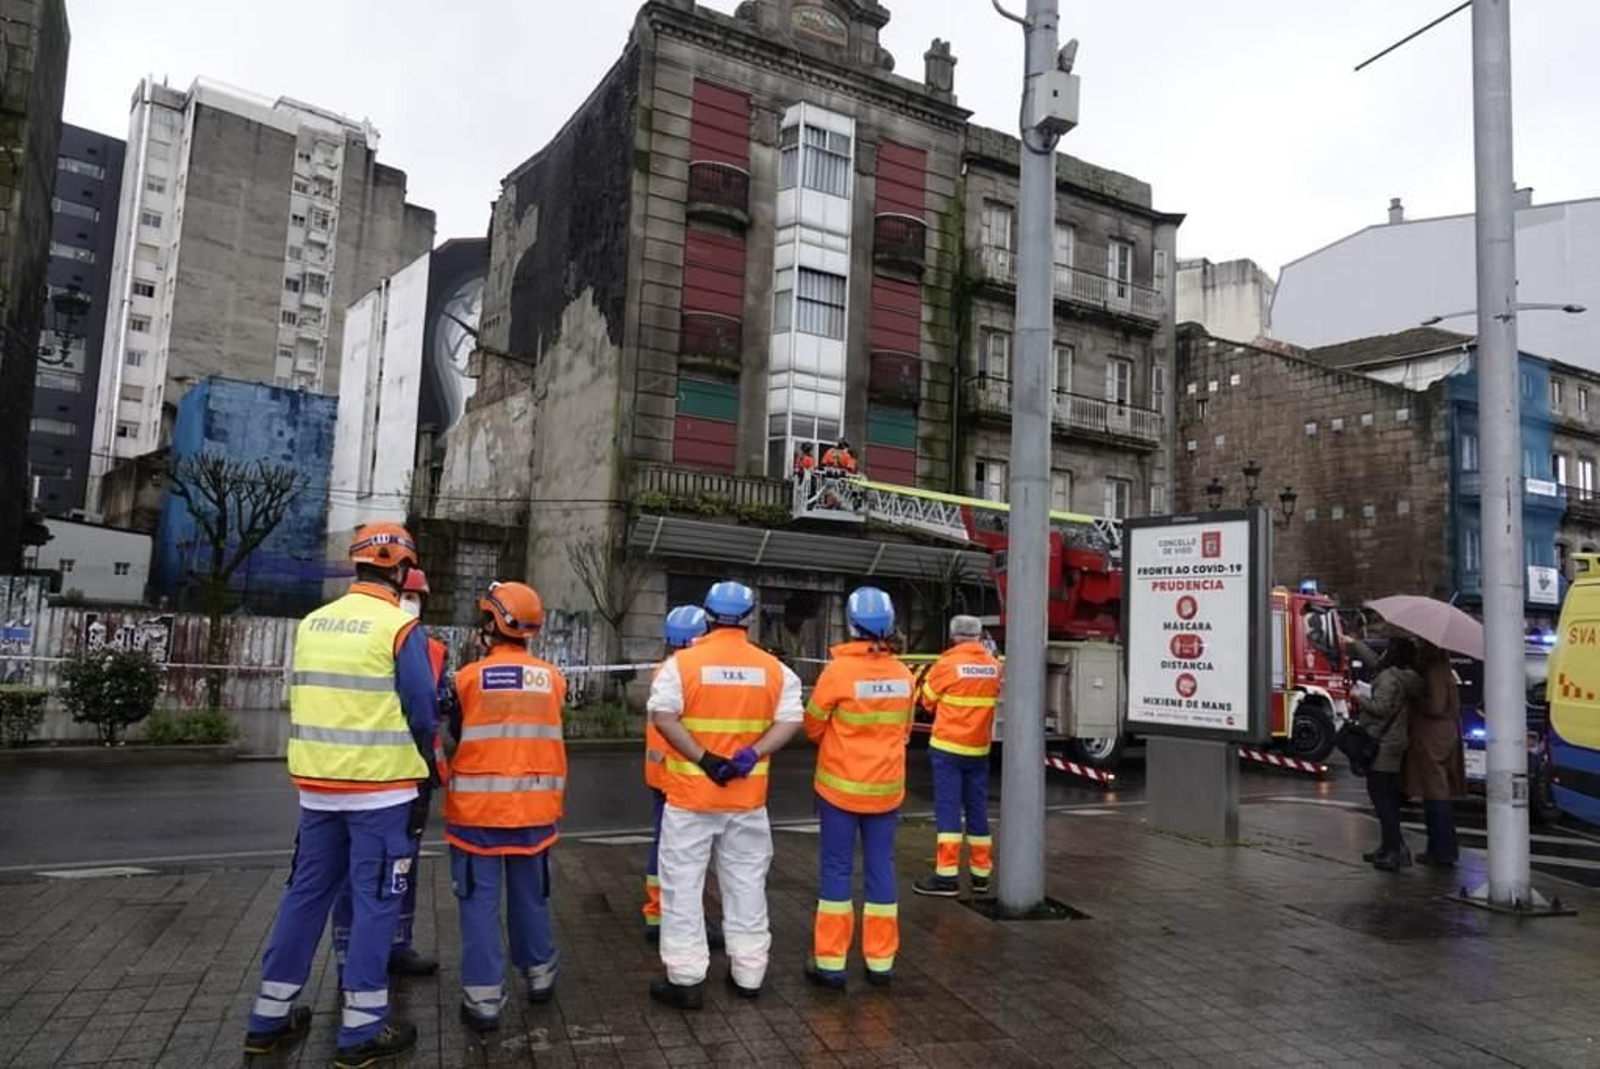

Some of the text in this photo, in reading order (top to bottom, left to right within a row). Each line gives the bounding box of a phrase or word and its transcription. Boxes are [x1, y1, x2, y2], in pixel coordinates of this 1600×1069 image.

[1137, 563, 1243, 576] FRONTE AO COVID-19
[1151, 579, 1225, 592] PRUDENCIA
[309, 618, 373, 634] TRIAGE
[1569, 627, 1597, 645] SVA
[1160, 661, 1214, 671] DISTANCIA
[1143, 697, 1232, 712] HIXIENE DE MANS
